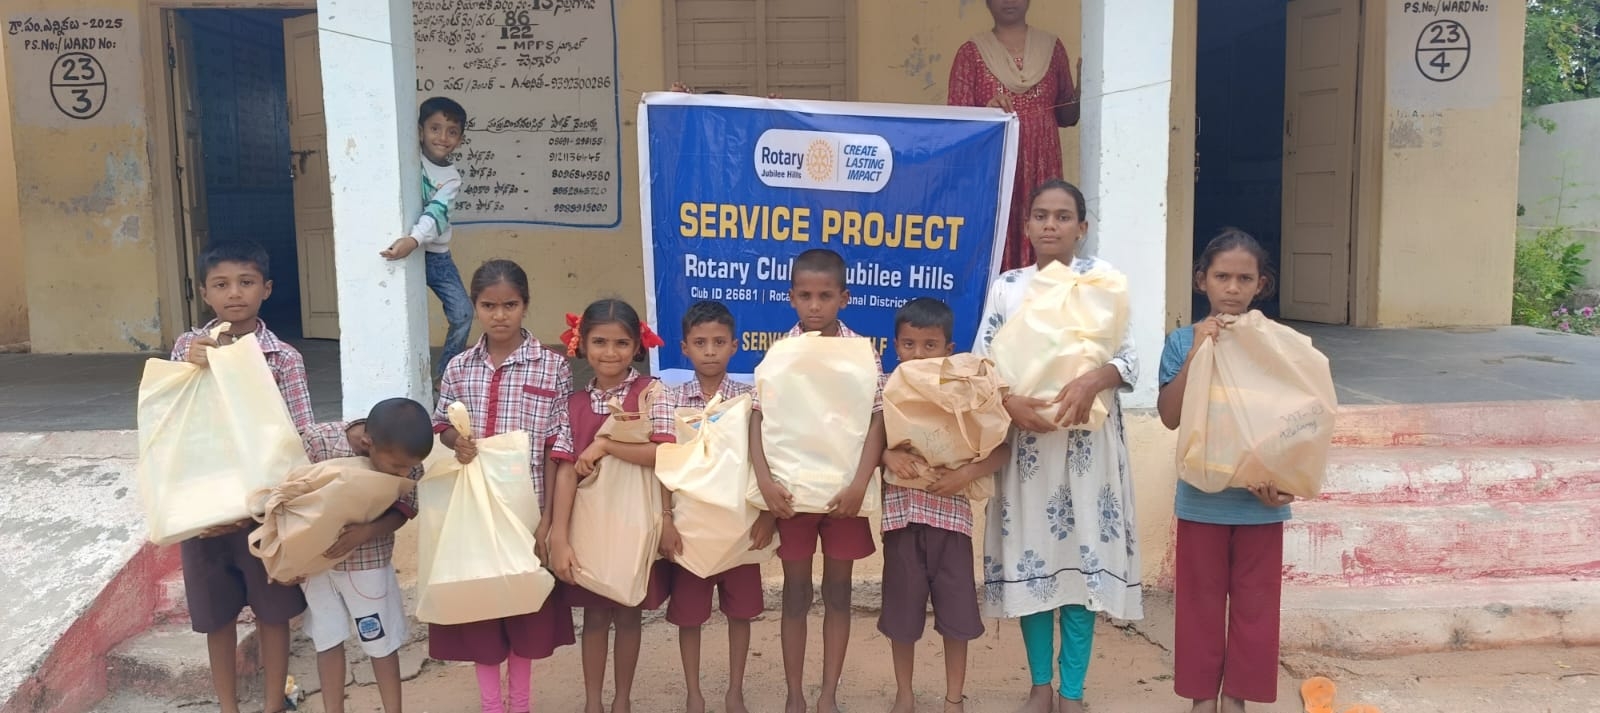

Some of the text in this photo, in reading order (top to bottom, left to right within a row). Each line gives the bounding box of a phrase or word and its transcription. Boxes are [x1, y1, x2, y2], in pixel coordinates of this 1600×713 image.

[1442, 0, 1471, 13] WARD
[505, 10, 530, 26] 86
[500, 26, 534, 39] 122
[1429, 25, 1460, 43] 23
[63, 38, 96, 50] WARD
[98, 37, 116, 49] No:
[513, 40, 554, 50] MPPS
[61, 57, 95, 81] 23
[1429, 52, 1450, 73] 4
[71, 89, 92, 113] 3
[761, 147, 805, 170] Rotary
[843, 144, 878, 157] CREATE
[845, 157, 885, 169] LASTING
[761, 169, 802, 179] Jubilee Hills
[847, 170, 883, 182] IMPACT
[679, 202, 965, 251] SERVICE PROJECT
[684, 254, 750, 285] Rotary
[845, 263, 902, 288] ubilee
[909, 265, 954, 290] Hills
[691, 286, 709, 299] Club
[711, 288, 722, 300] ID
[725, 288, 758, 301] 26681
[769, 290, 790, 302] Rota
[869, 295, 908, 308] District
[742, 332, 789, 351] SERV
